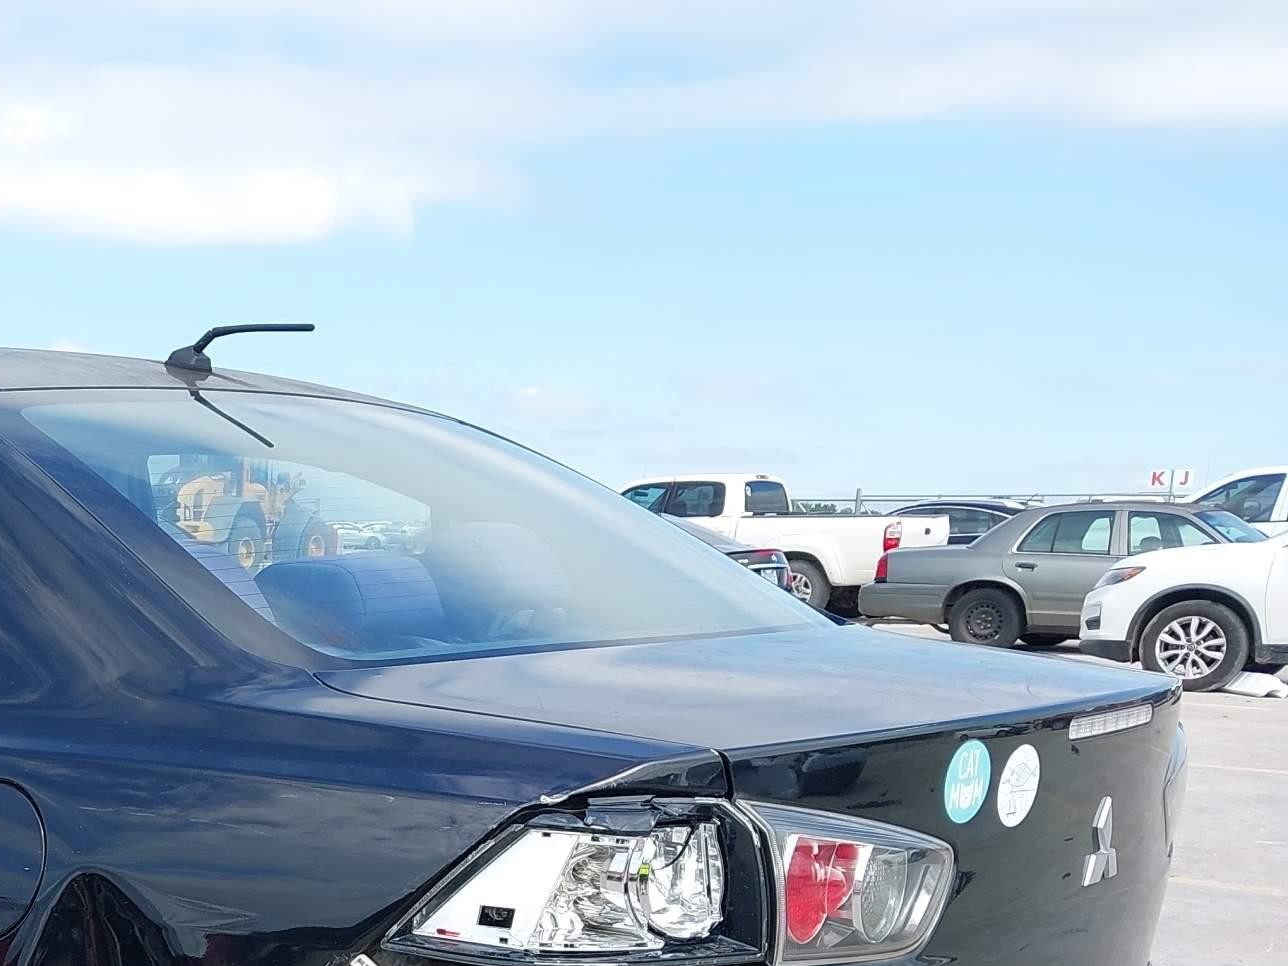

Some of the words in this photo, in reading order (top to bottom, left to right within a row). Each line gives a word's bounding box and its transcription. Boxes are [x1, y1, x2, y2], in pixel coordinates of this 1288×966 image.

[1151, 471, 1166, 486] K
[1179, 470, 1190, 486] J
[958, 748, 983, 780] CAT
